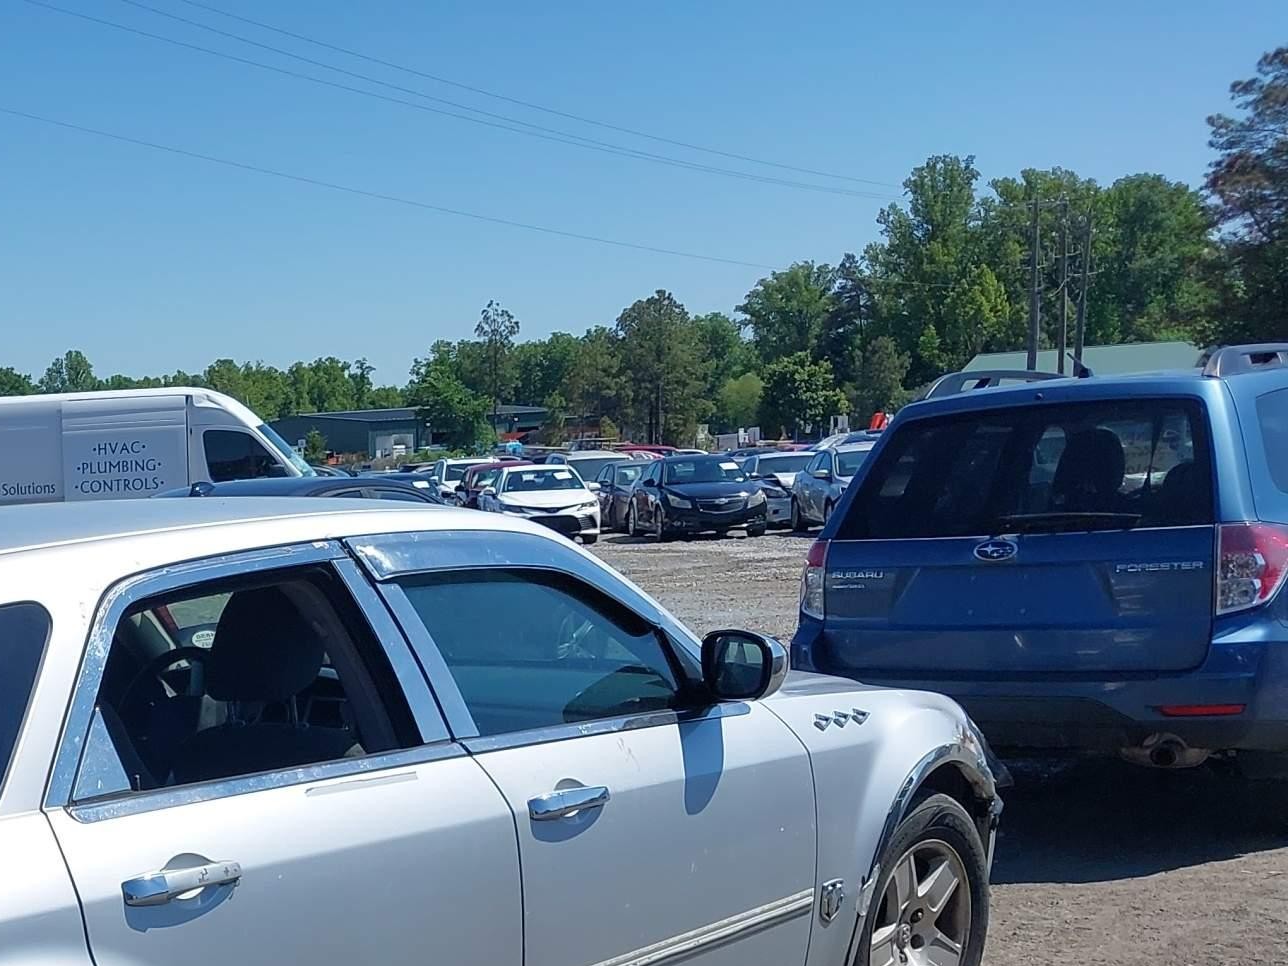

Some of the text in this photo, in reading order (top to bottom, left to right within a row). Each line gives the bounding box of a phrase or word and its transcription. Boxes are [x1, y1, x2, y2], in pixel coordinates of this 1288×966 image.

[2, 480, 56, 496] Solutions
[1116, 561, 1205, 574] FORESTER
[831, 571, 884, 580] SUBARU
